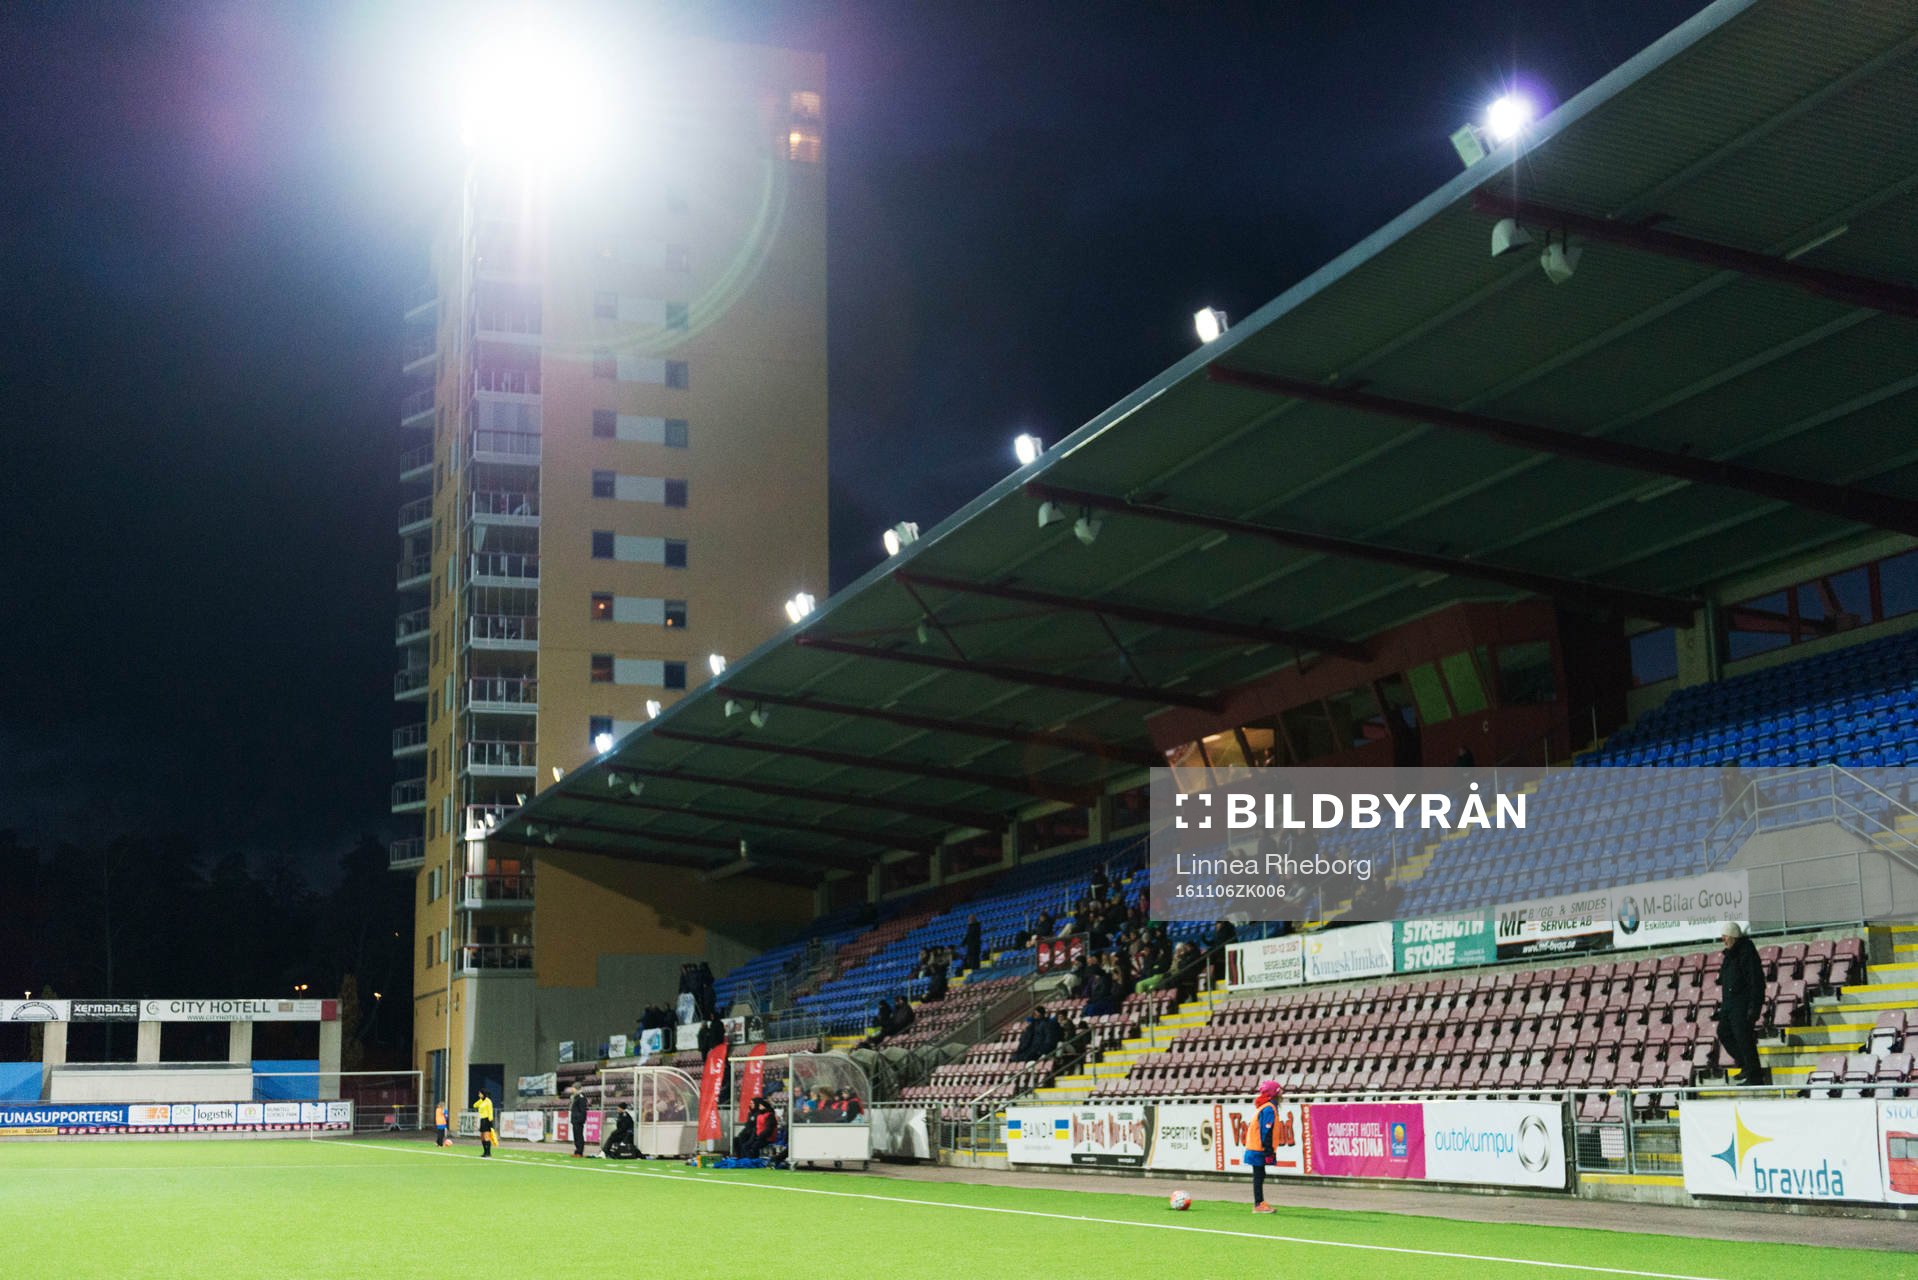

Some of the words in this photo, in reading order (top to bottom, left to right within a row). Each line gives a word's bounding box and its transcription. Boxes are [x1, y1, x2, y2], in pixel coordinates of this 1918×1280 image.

[1571, 897, 1607, 913] SMIDES
[1643, 894, 1695, 915] M-Bilar
[1698, 889, 1743, 909] Group
[1402, 910, 1485, 944] STRENGTH
[1499, 908, 1528, 937] MF
[1540, 917, 1577, 932] SERVICE
[1579, 915, 1592, 926] AB
[1644, 919, 1681, 931] Eskilstuna
[1403, 941, 1456, 971] STORE
[170, 1001, 205, 1014] CITY
[210, 1001, 271, 1013] HOTELL
[197, 1108, 233, 1121] logistik
[1161, 1125, 1198, 1141] SPORTIVE
[1215, 1107, 1223, 1170] varubud.se
[1303, 1105, 1312, 1173] varubud.se
[1327, 1122, 1359, 1137] COMFORT
[1328, 1137, 1384, 1157] ESKILSTUNA
[1434, 1127, 1514, 1158] outokumpu
[1753, 1157, 1844, 1196] bravida
